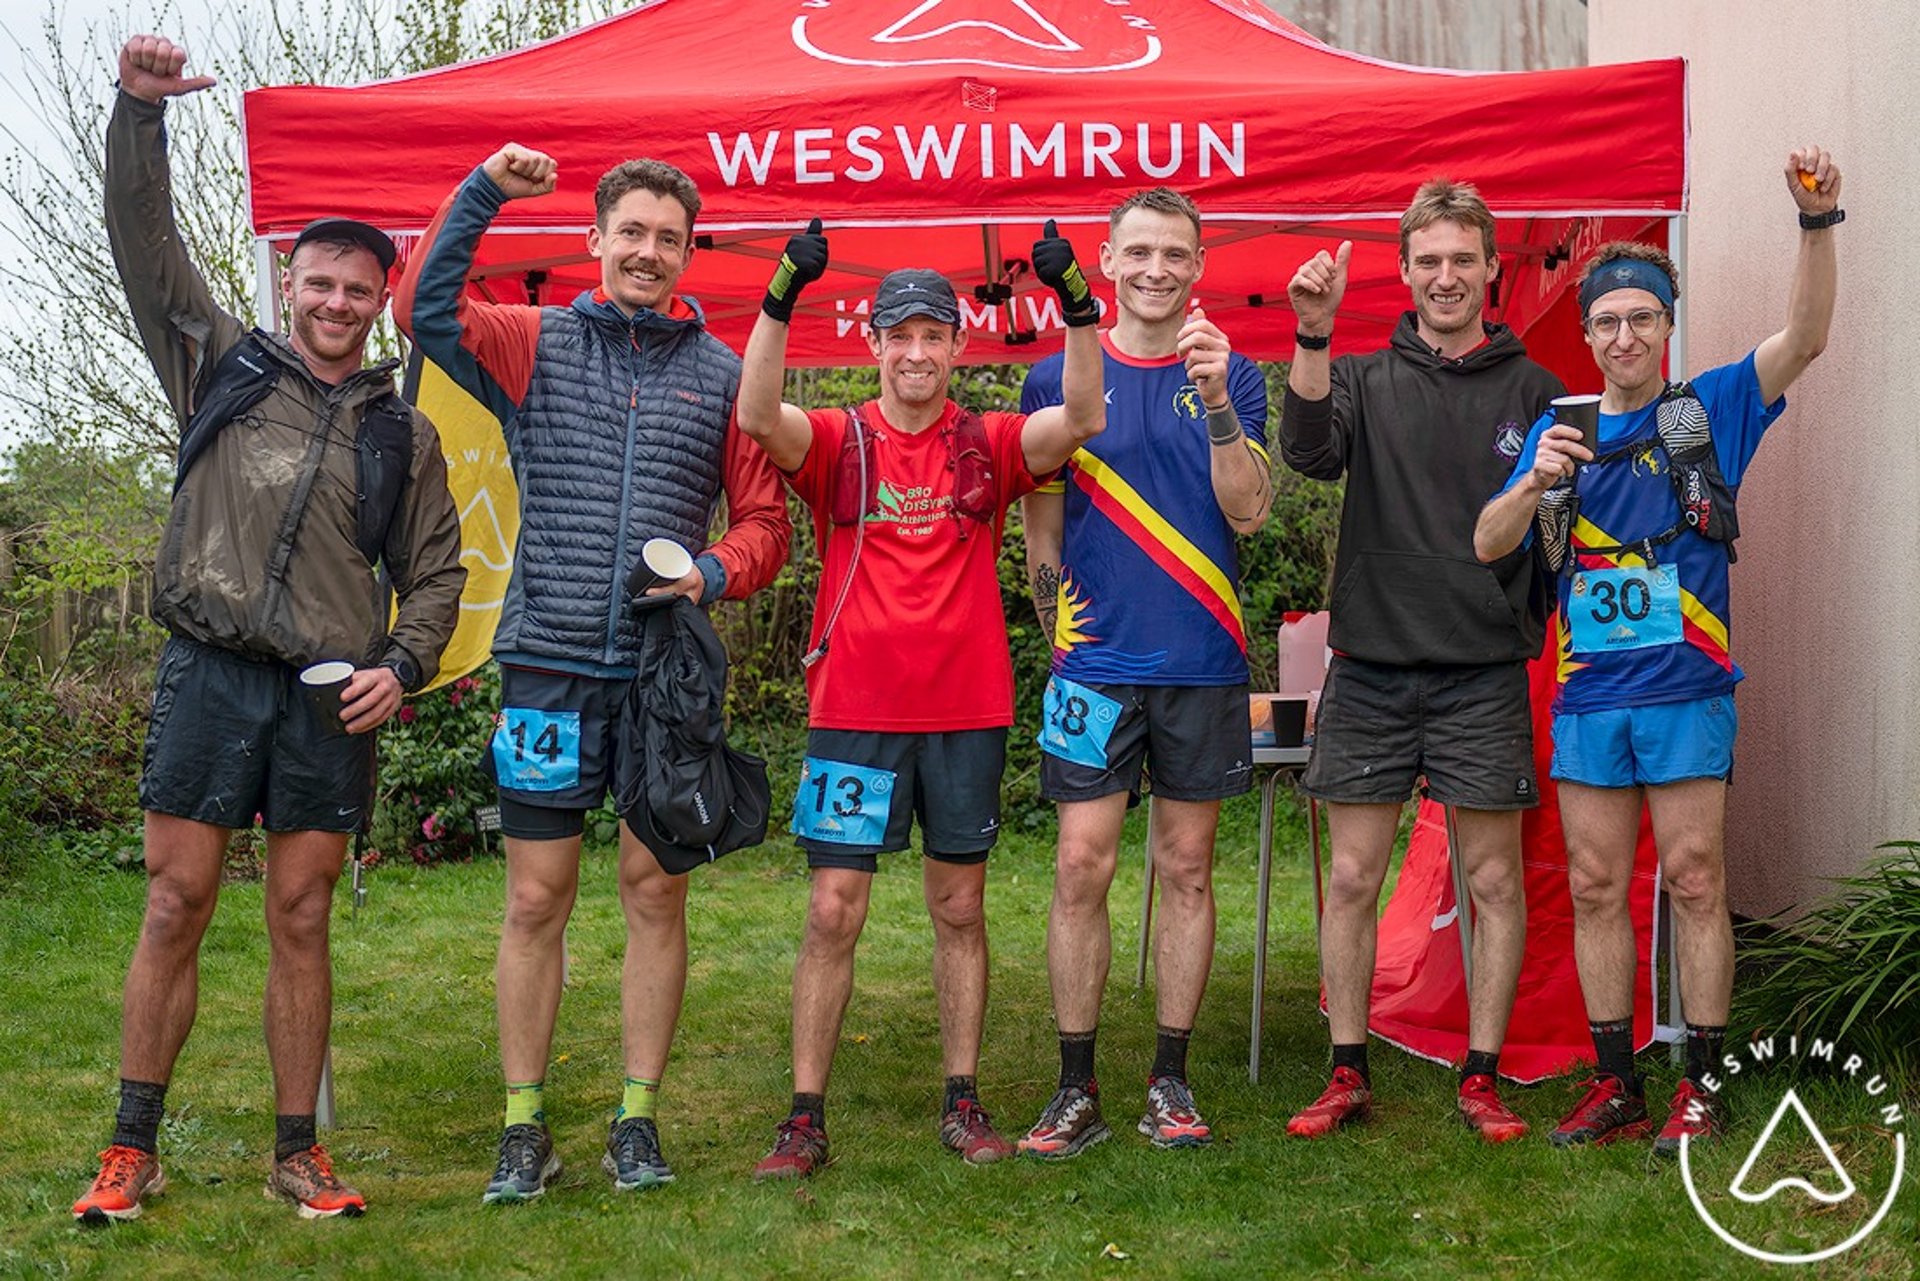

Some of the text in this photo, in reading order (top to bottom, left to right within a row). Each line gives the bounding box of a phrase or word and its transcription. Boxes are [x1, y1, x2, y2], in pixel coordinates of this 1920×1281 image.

[707, 122, 1245, 187] WESWIMRUN
[906, 486, 932, 500] BRO
[1590, 577, 1651, 624] 30
[510, 721, 563, 763] 14
[811, 772, 865, 817] 13
